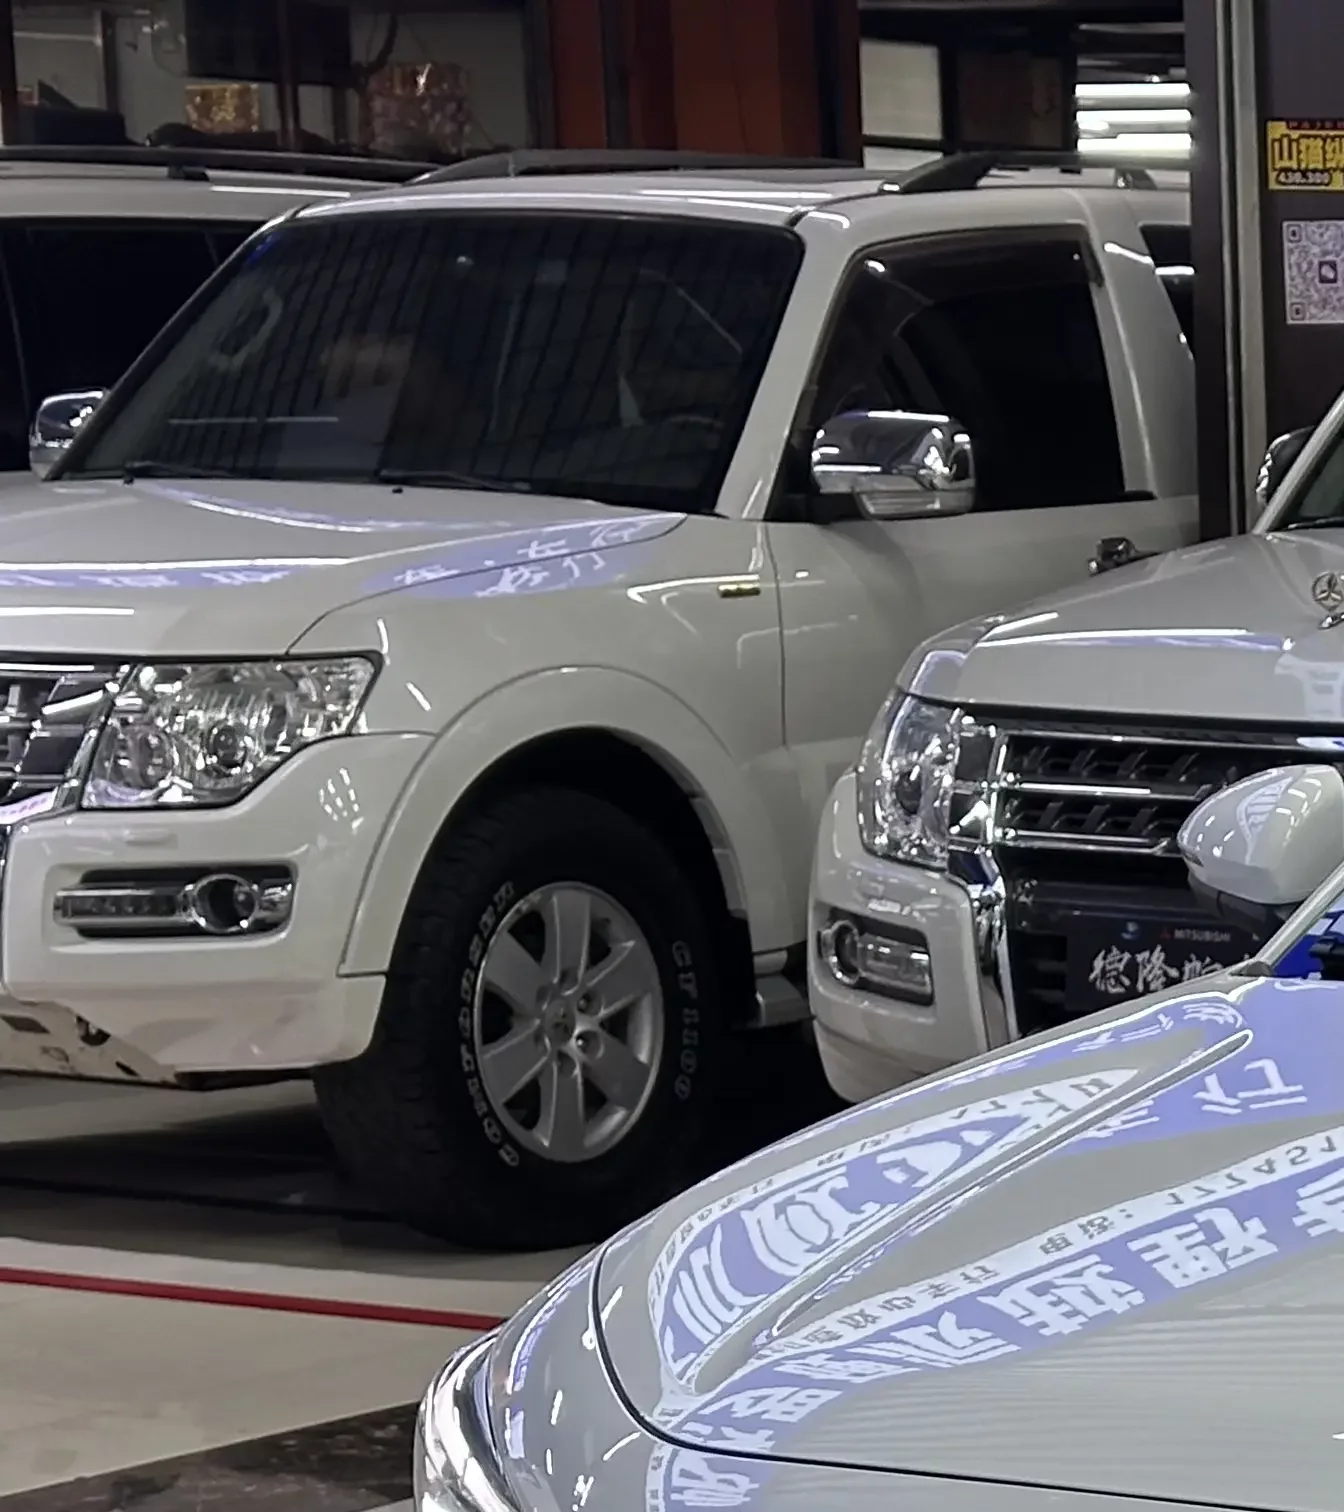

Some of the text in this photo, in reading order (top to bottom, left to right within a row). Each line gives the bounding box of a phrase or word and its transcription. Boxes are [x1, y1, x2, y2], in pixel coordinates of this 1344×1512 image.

[1173, 929, 1231, 942] MITSUBISHI
[1088, 945, 1250, 994] 德隆帕
